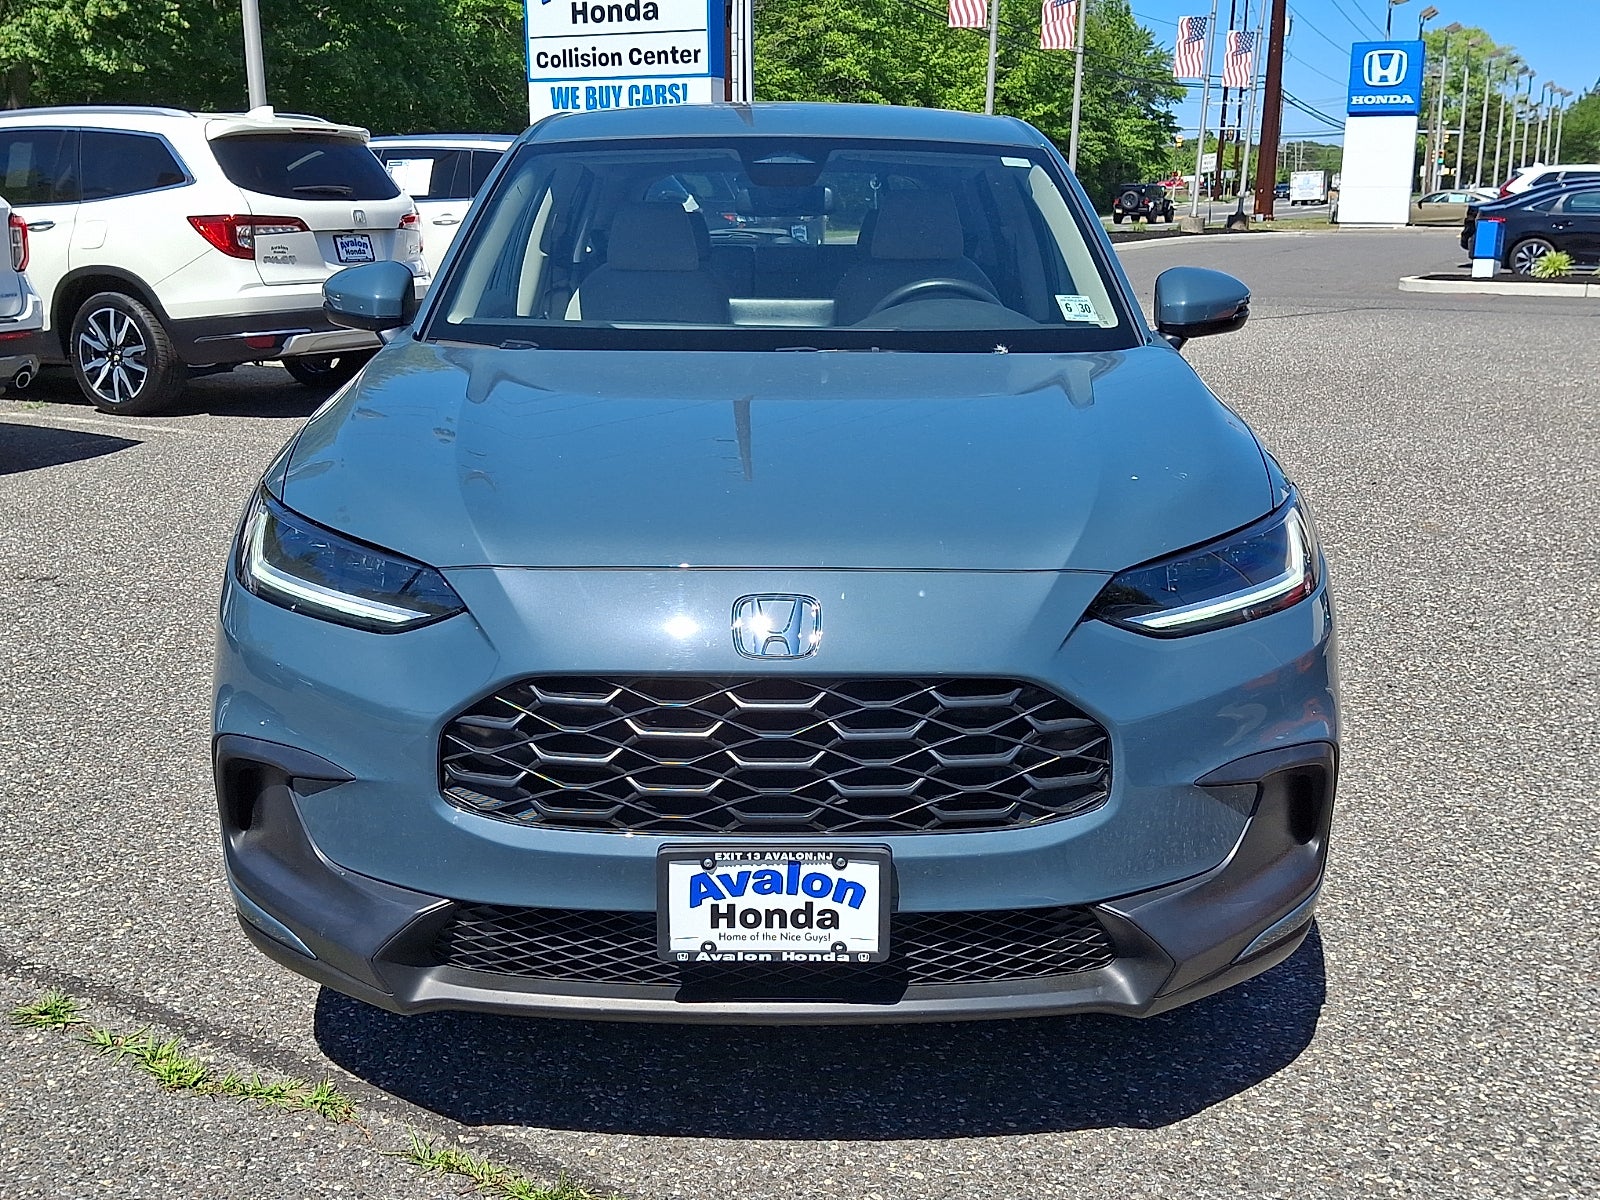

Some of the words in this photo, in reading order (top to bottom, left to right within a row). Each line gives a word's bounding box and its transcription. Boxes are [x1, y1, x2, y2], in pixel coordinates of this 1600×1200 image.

[571, 0, 659, 24] Honda
[536, 46, 623, 69] Collision
[628, 46, 702, 66] Center
[550, 86, 580, 109] WE
[585, 85, 622, 110] BUY
[628, 83, 688, 106] CARS!
[1350, 94, 1415, 105] HONDA
[340, 238, 369, 250] Avalon
[1065, 302, 1072, 312] 6
[1078, 303, 1091, 313] 30
[714, 852, 743, 861] EXIT
[746, 852, 761, 861] 13
[689, 861, 867, 909] Avalon
[710, 901, 840, 930] Honda
[718, 932, 747, 941] Home
[750, 932, 760, 941] of
[762, 932, 777, 941] the
[780, 932, 801, 941] Nice
[804, 932, 831, 942] Guys!
[695, 951, 772, 962] Avalon
[781, 951, 850, 962] Honda
